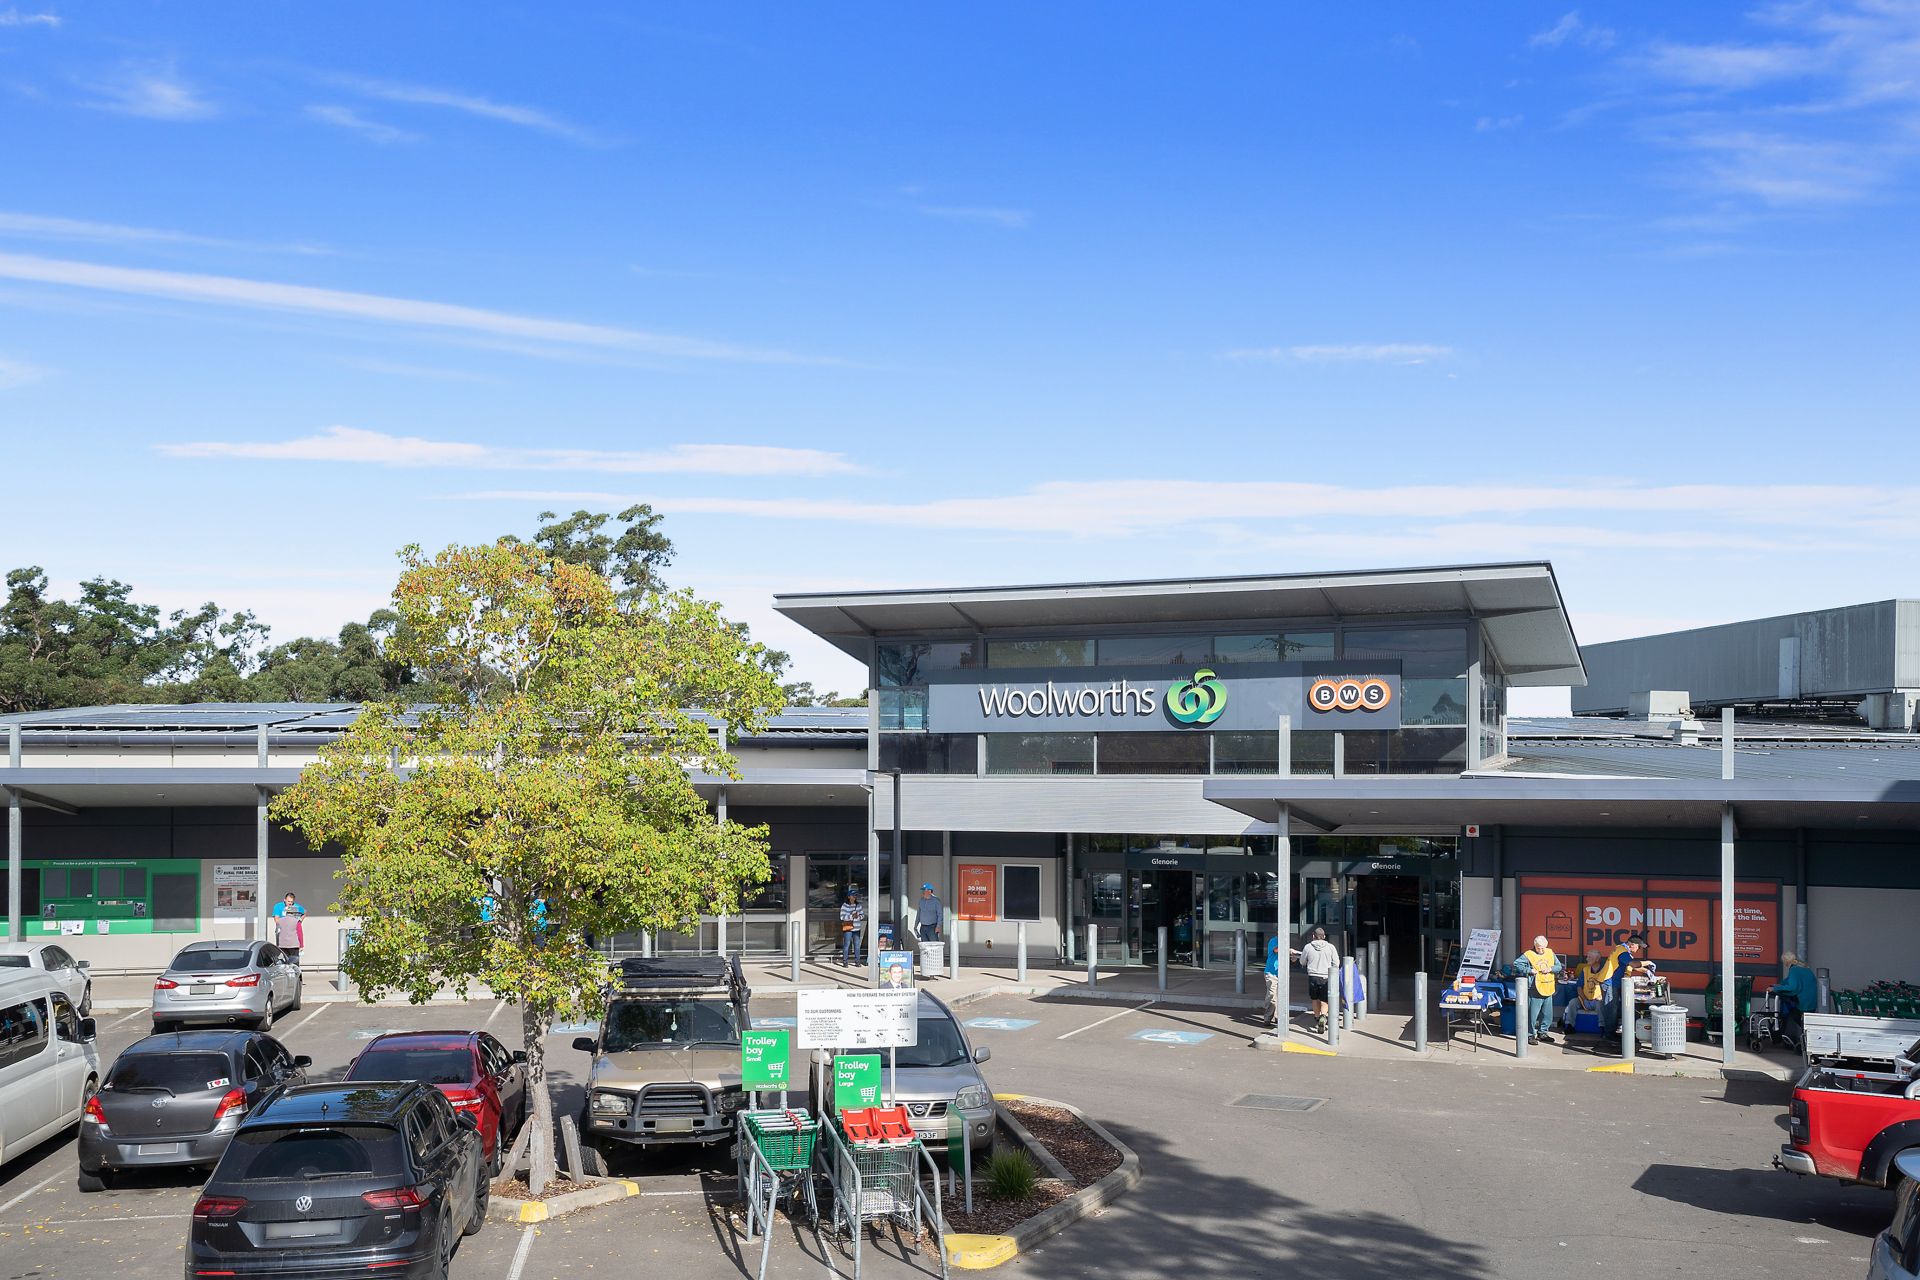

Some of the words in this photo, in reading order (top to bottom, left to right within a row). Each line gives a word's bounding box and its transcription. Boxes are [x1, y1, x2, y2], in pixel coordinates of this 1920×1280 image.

[979, 680, 1156, 715] Woolworths
[1151, 858, 1179, 866] Glenorie
[1371, 862, 1401, 870] Glenorie
[1585, 906, 1621, 926] 30
[1629, 907, 1684, 928] MIN
[1658, 930, 1698, 949] UP
[746, 1036, 777, 1047] Trolley
[746, 1046, 763, 1056] bay
[838, 1061, 869, 1071] Trolley
[838, 1070, 856, 1081] bay
